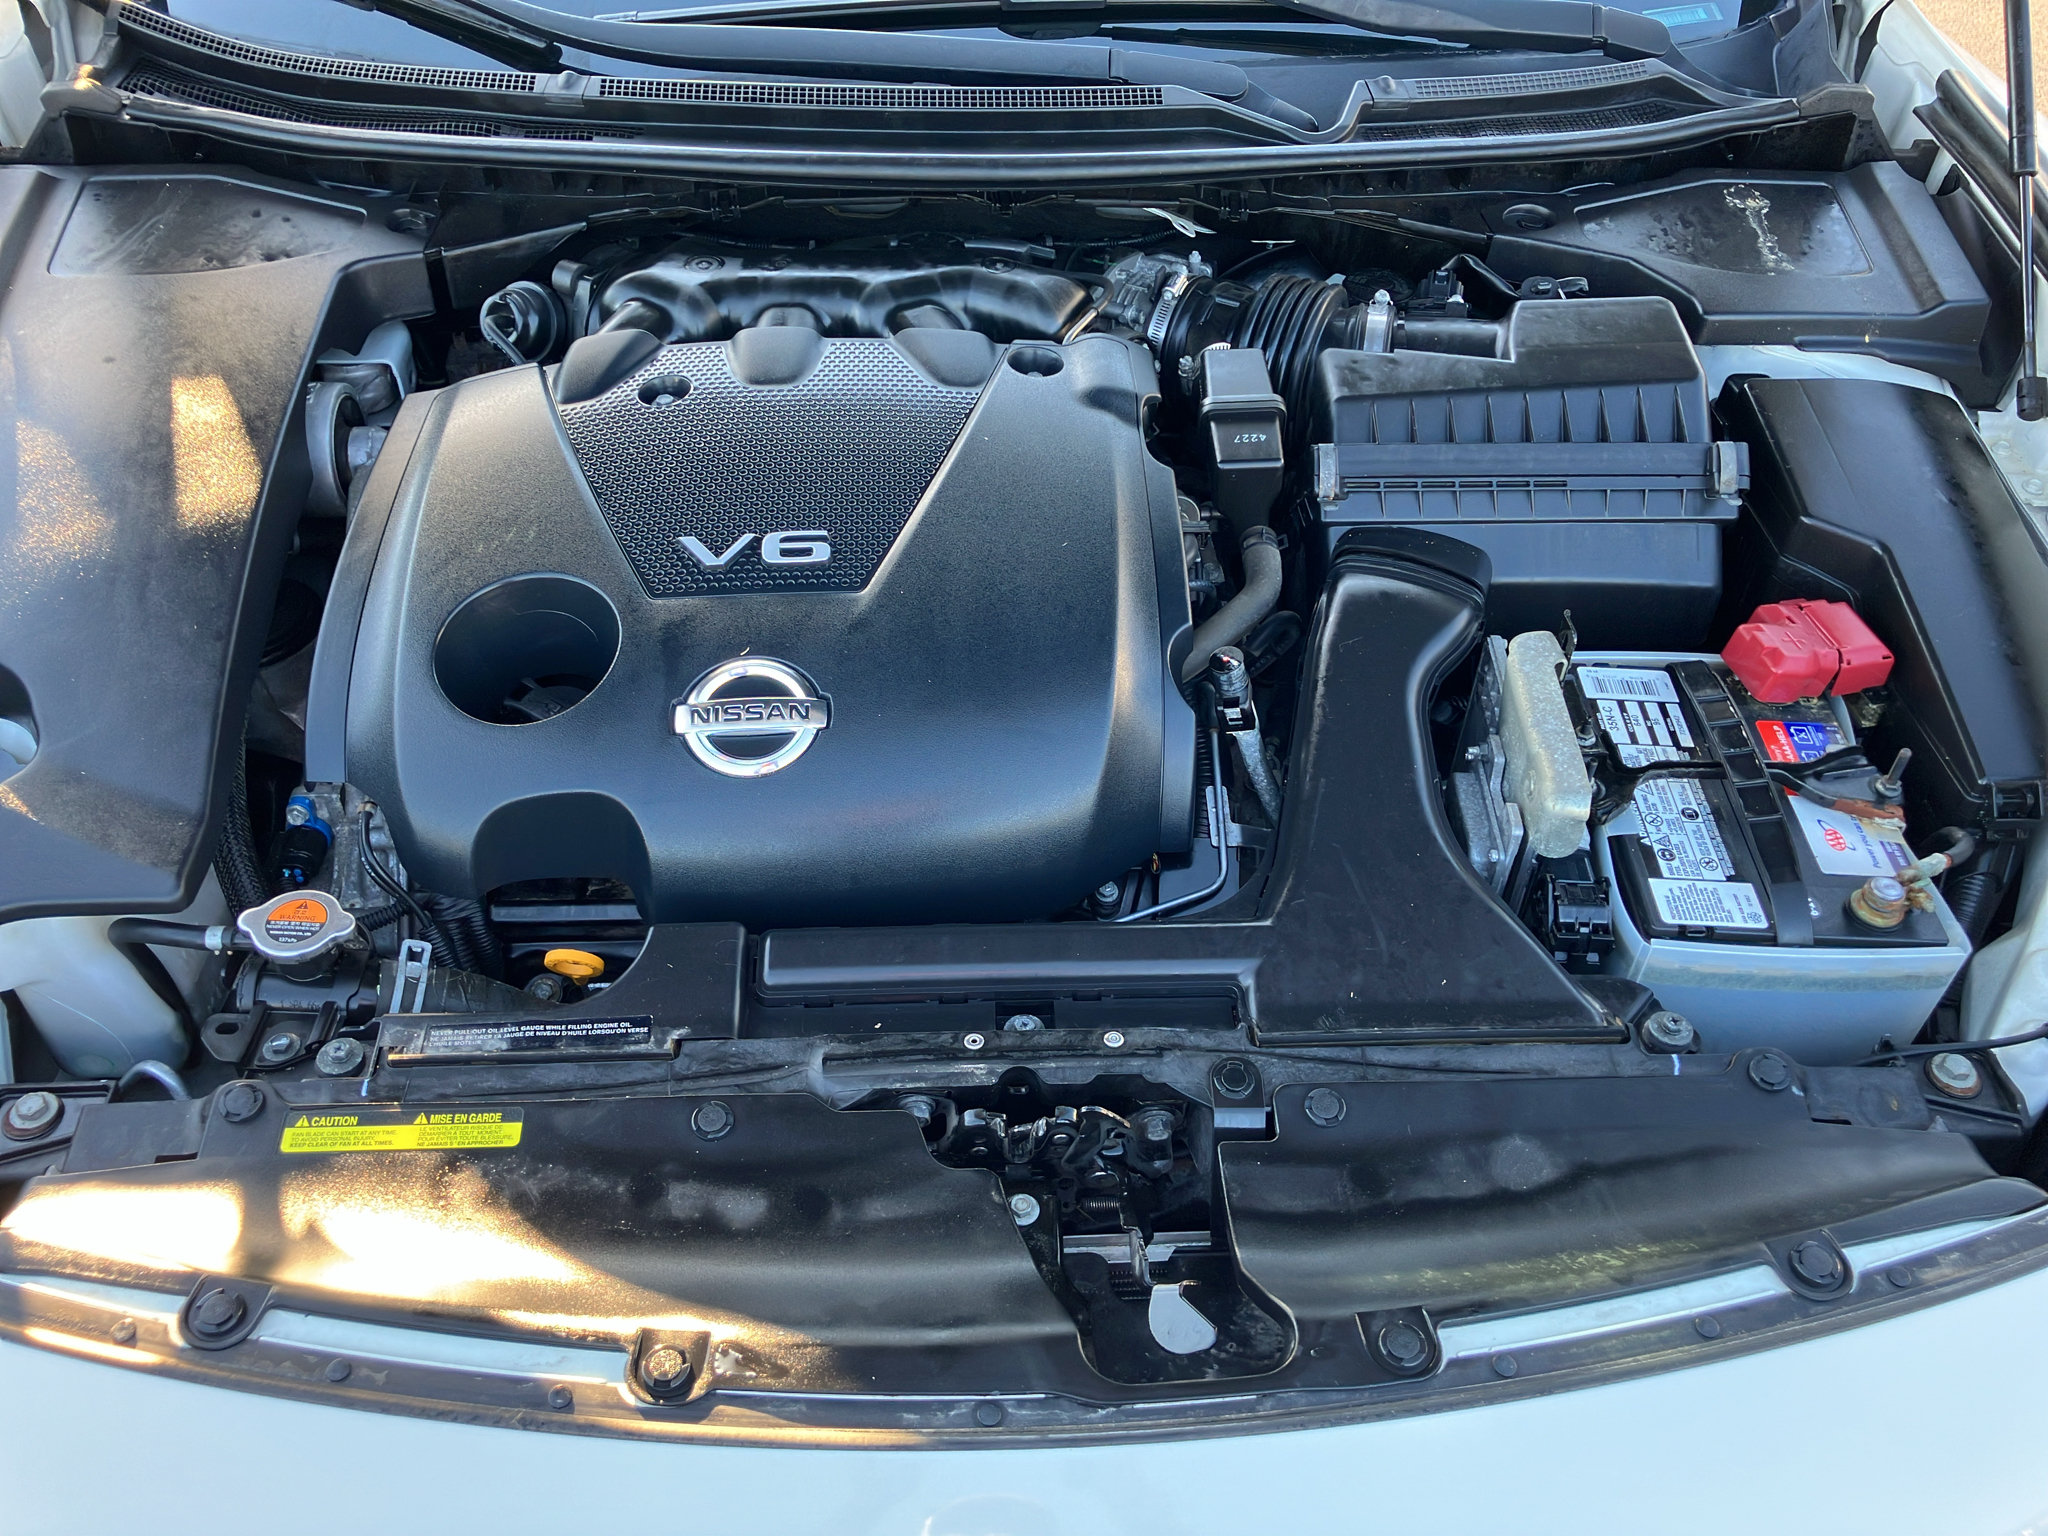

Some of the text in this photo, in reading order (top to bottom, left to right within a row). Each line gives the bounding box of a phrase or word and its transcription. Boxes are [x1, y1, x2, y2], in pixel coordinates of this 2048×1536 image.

[1234, 433, 1267, 443] 4227
[676, 530, 831, 569] V6
[690, 702, 811, 724] NISSAN
[1824, 828, 1846, 850] AAA
[1858, 832, 1872, 846] you
[1866, 847, 1882, 868] Power
[311, 1116, 358, 1126] CAUTION
[430, 1113, 502, 1124] MISE EN GARDE
